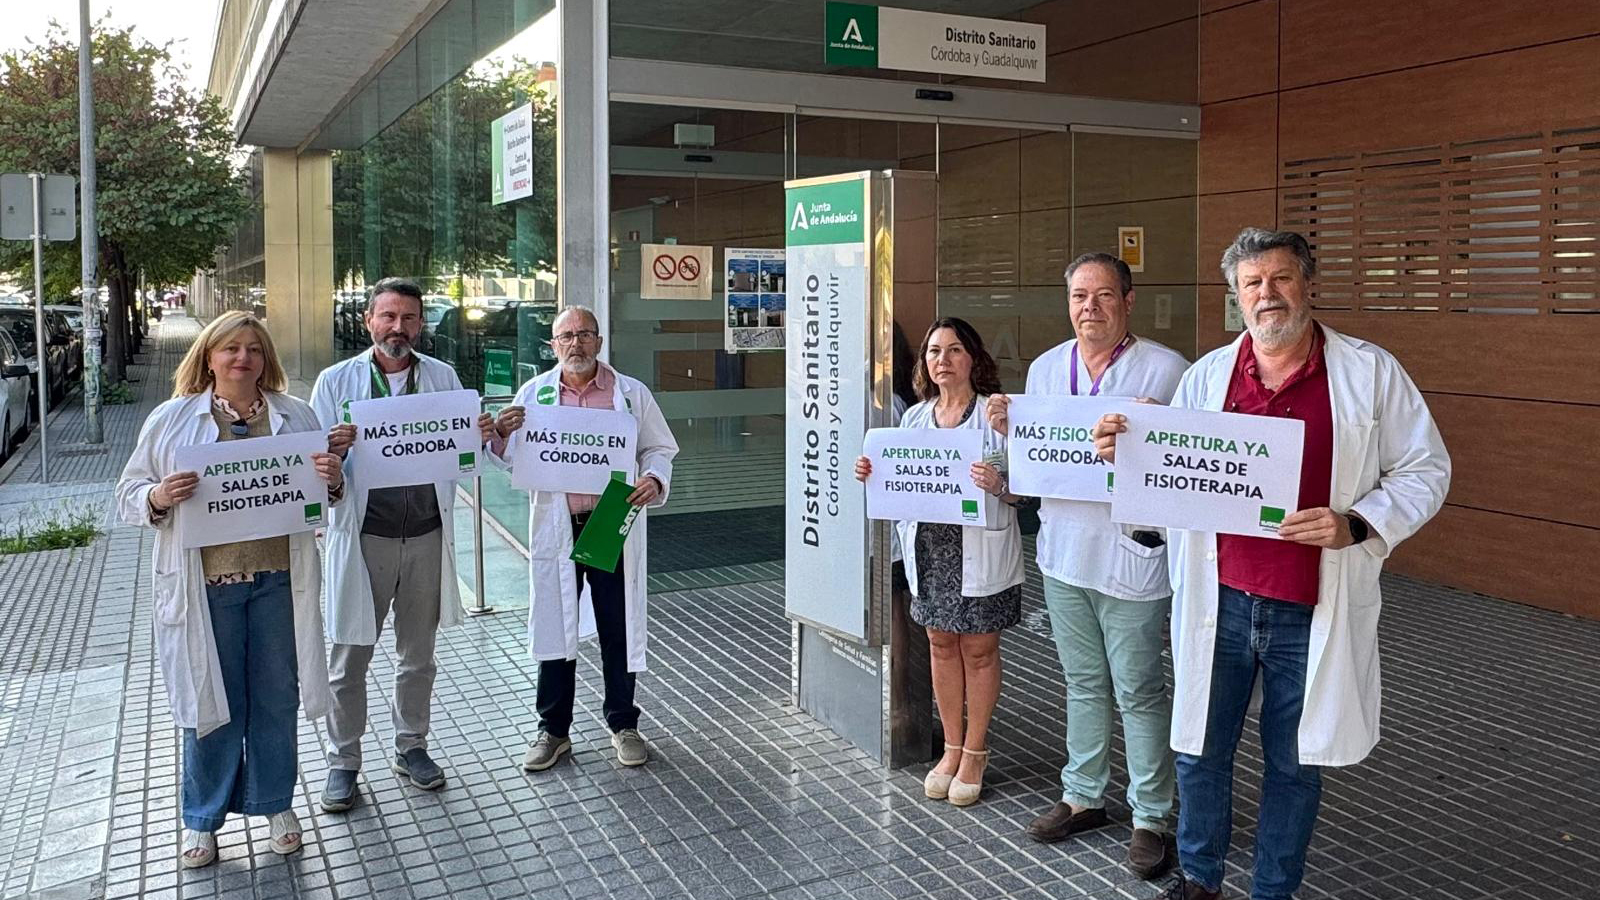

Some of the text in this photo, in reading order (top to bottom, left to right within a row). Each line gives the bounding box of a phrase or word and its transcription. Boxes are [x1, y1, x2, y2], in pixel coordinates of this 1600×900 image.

[946, 27, 1036, 50] Distrito Sanitario
[931, 45, 1038, 71] Córdoba y Guadalquivir
[810, 202, 831, 213] Junta
[810, 210, 858, 225] de Andalucía
[825, 272, 843, 518] Córdoba y Guadalquivir
[802, 273, 820, 548] Distrito Sanitario
[364, 417, 471, 440] MÁS FISIOS EN
[526, 428, 626, 448] MÁS FISIOS EN
[1014, 421, 1046, 440] MÁS
[381, 438, 457, 457] CÓRDOBA
[881, 447, 962, 461] APERTURA YA
[1028, 444, 1106, 466] CÓRDOBA
[1145, 430, 1270, 458] APERTURA YA
[203, 454, 304, 478] APERTURA YA
[540, 447, 610, 466] CÓRDOBA
[1162, 453, 1248, 477] SALAS DE
[895, 464, 950, 477] SALAS DE
[221, 473, 290, 493] SALAS DE
[885, 480, 962, 495] FISIOTERAPIA
[1144, 473, 1264, 500] FISIOTERAPIA
[207, 490, 306, 514] FISIOTERAPIA
